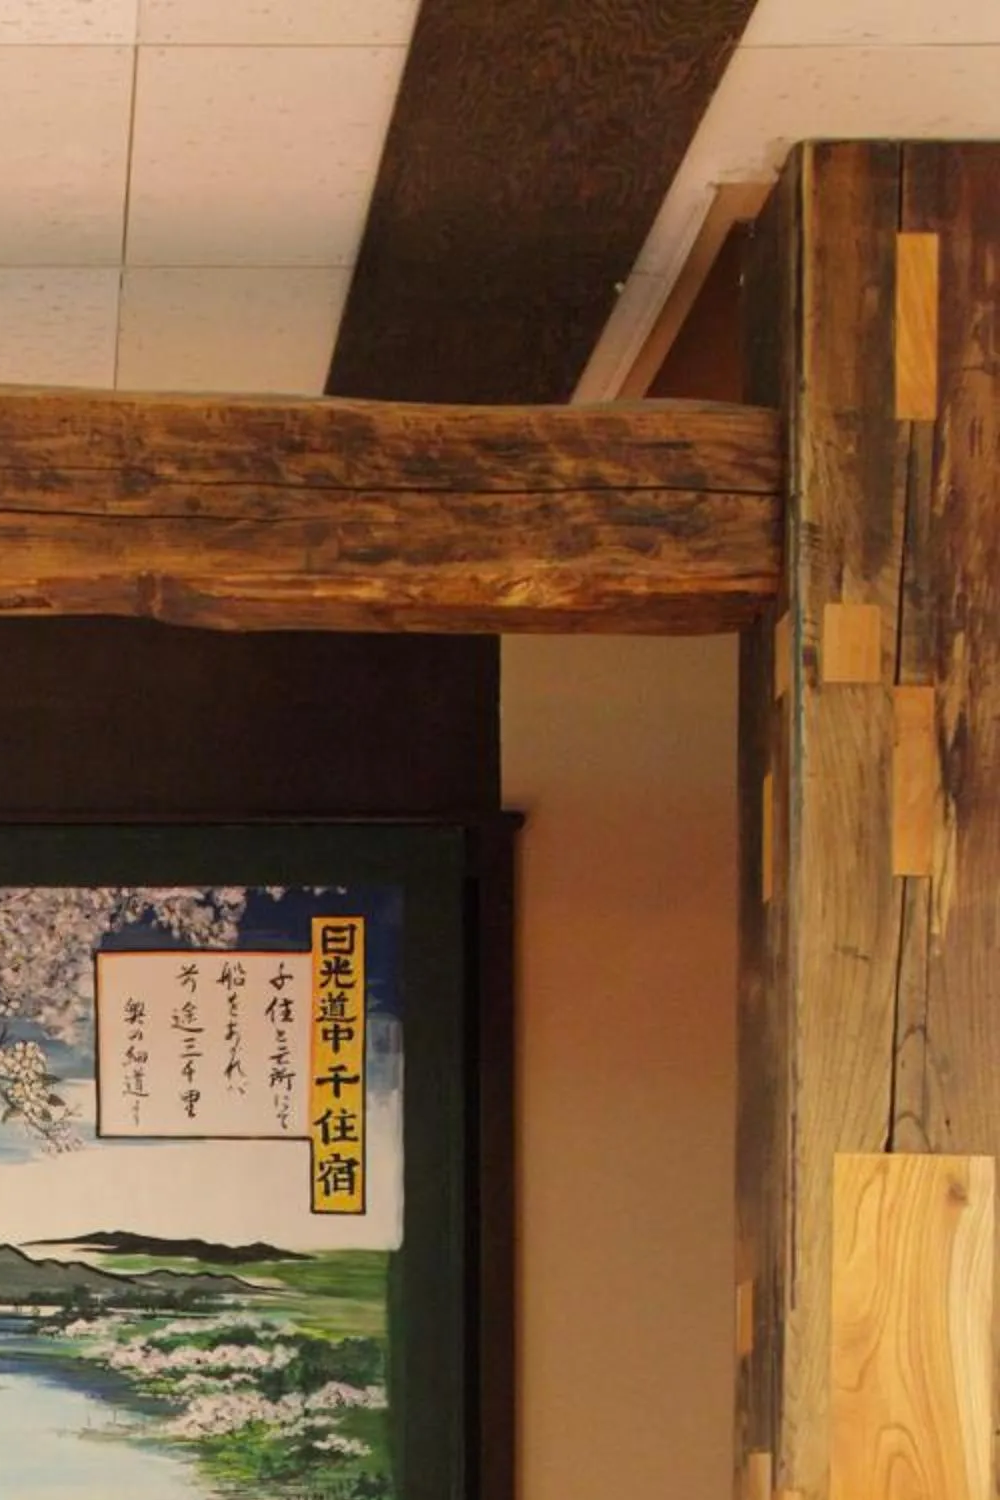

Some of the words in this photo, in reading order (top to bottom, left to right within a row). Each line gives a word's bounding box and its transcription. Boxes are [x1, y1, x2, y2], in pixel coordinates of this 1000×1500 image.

[314, 924, 360, 1196] 日光道中千住宿
